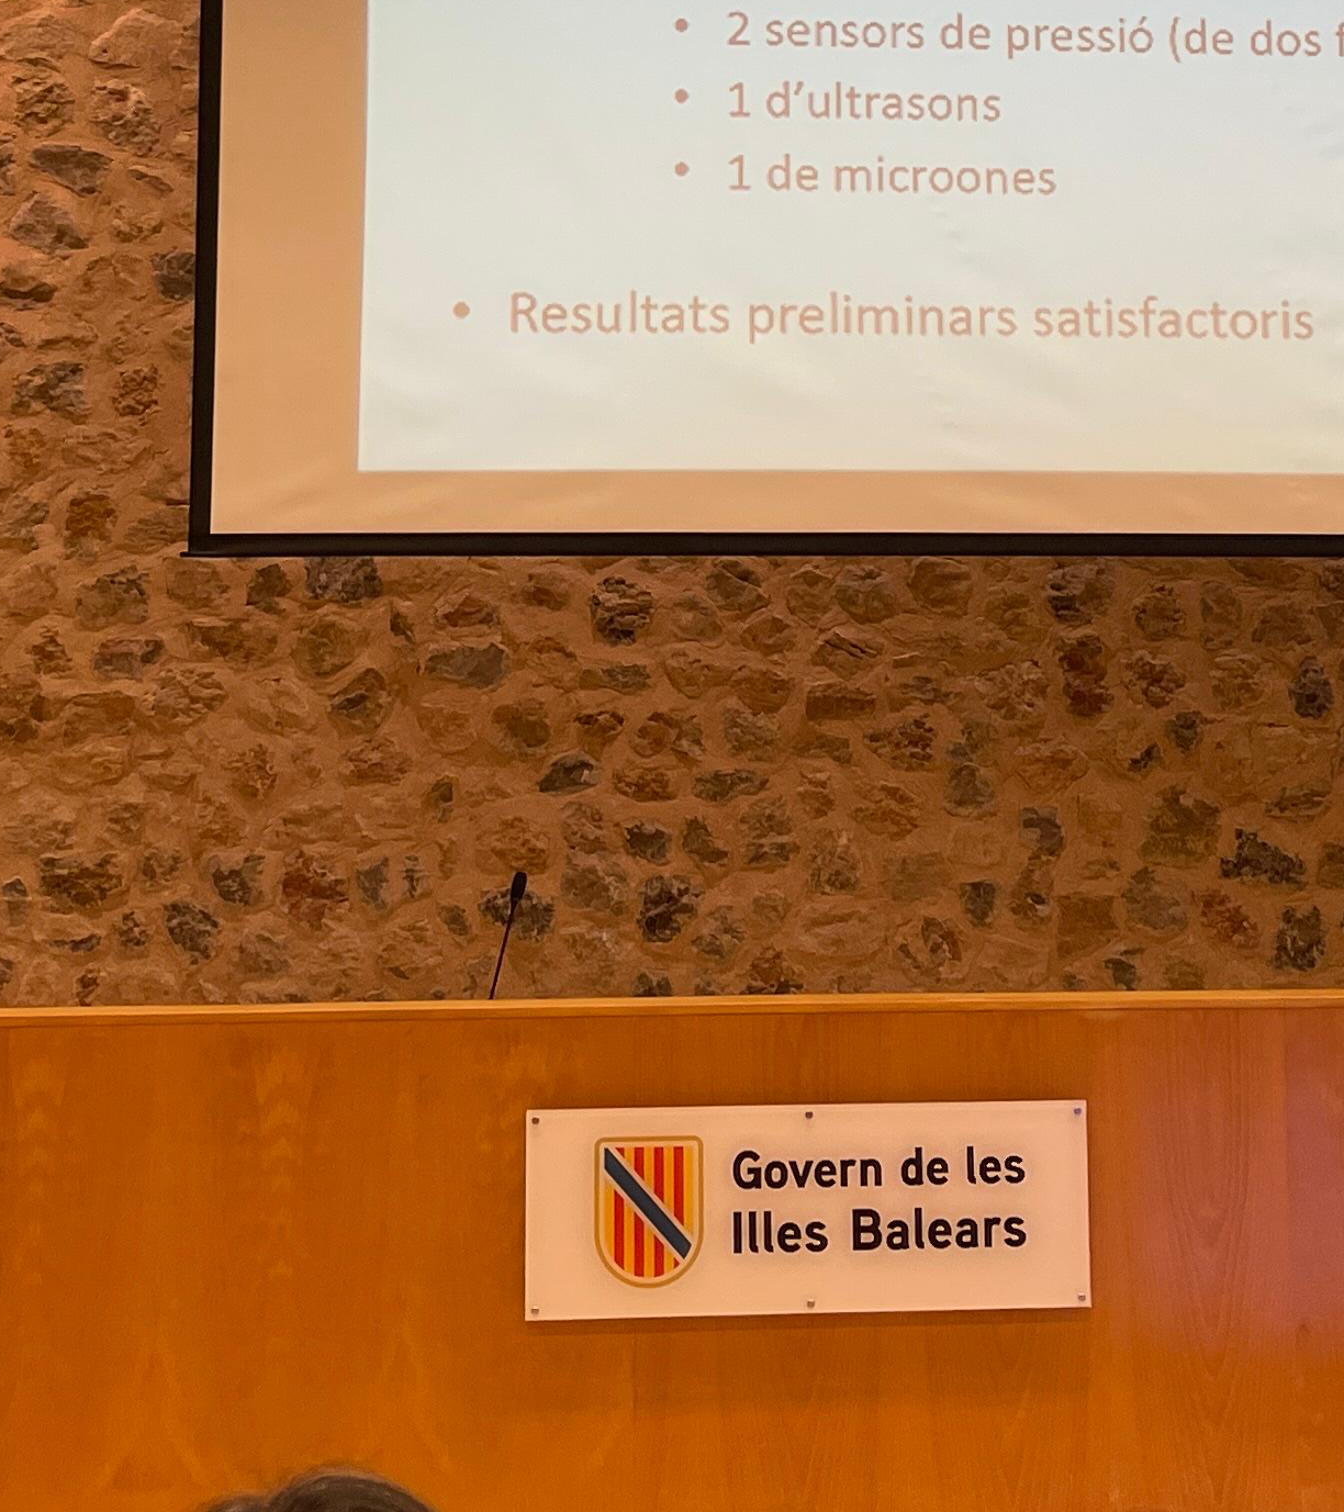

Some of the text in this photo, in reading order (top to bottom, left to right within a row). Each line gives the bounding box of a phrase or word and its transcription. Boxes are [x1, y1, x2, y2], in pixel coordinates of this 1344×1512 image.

[727, 11, 751, 46] 2
[765, 19, 924, 49] sensors
[940, 12, 991, 51] de
[1007, 15, 1154, 60] pressió
[1169, 16, 1234, 63] (de
[1250, 19, 1322, 57] dos
[729, 81, 751, 118] 1
[728, 153, 1057, 196] 1 de microones
[510, 289, 1314, 345] Resultats preliminars satisfactoris
[732, 1145, 1026, 1190] Govern de les
[733, 1207, 1027, 1254] Illes Balears
